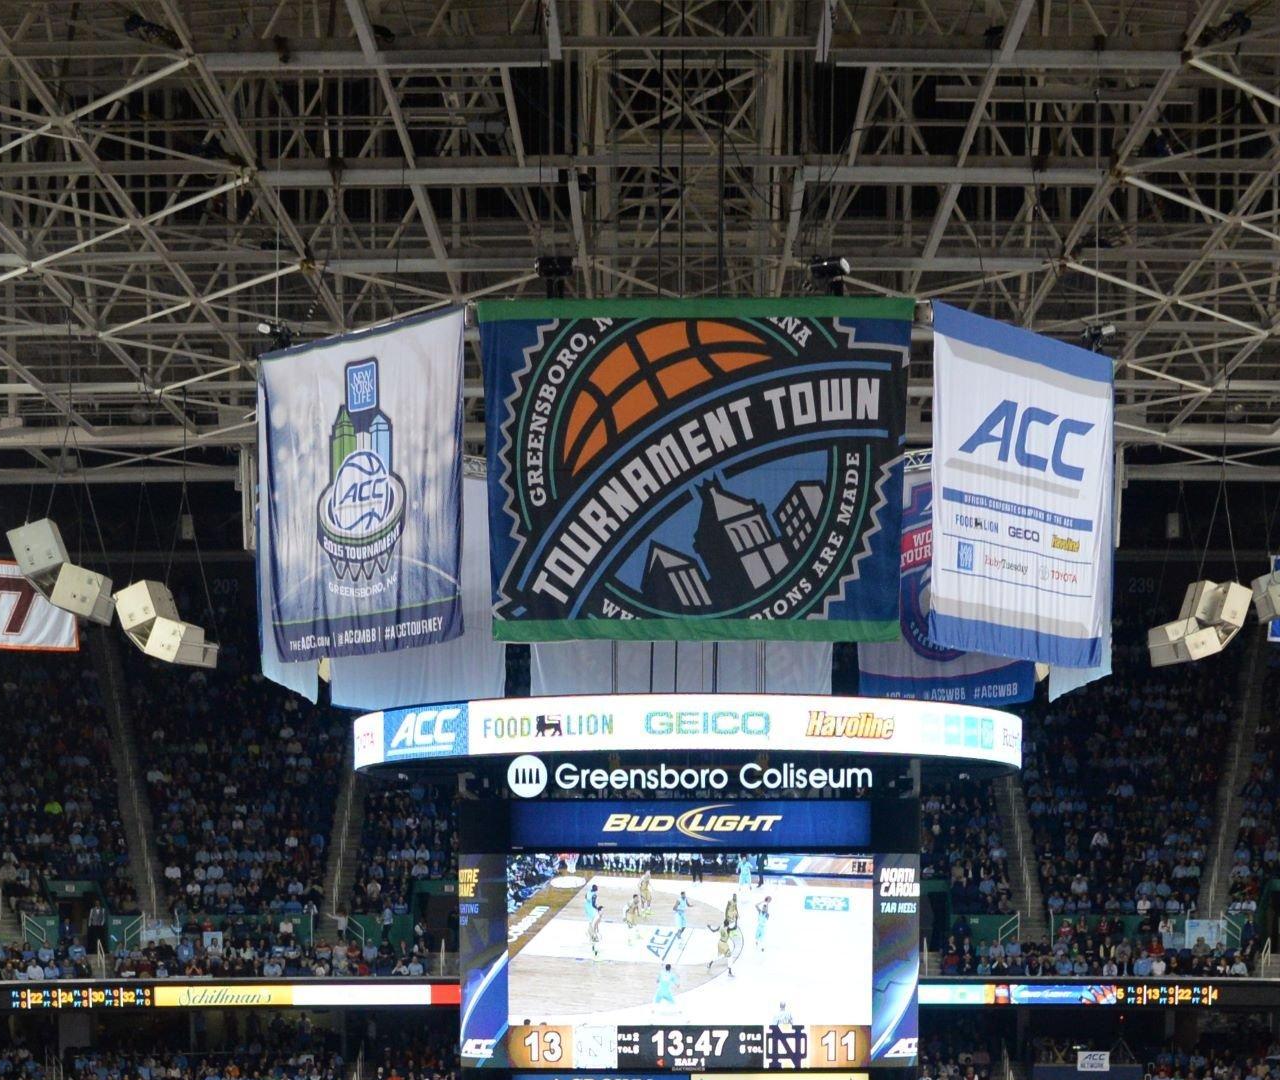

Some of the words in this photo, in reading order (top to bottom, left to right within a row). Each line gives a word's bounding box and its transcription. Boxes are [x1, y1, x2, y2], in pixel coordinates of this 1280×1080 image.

[353, 370, 372, 386] NEW
[353, 391, 372, 405] LIFE
[526, 332, 598, 507] GREENSBORO,
[958, 399, 1096, 482] ACC
[343, 478, 387, 504] ACC
[532, 397, 755, 606] TOURNAMENT
[764, 377, 881, 432] TOWN
[816, 531, 843, 580] ARE
[836, 451, 861, 527] MADE
[983, 519, 999, 534] LION
[324, 536, 344, 556] 2015
[345, 522, 401, 560] TOURNAMENT
[384, 616, 444, 641] #ACCTOURNEY
[973, 682, 1019, 699] #ACCWBB
[390, 708, 462, 747] ACC
[483, 717, 532, 739] FOOD
[566, 714, 615, 736] LION
[805, 710, 896, 740] Havoline
[554, 763, 729, 790] Greensboro
[739, 763, 873, 790] Coliseum
[602, 814, 675, 833] BUD
[687, 814, 784, 833] LIGHT
[879, 867, 916, 883] NORTH
[880, 902, 898, 914] TAR
[898, 902, 917, 914] HEELS
[30, 992, 43, 1004] 22
[61, 991, 74, 1003] 24
[91, 991, 105, 1003] 30
[122, 991, 136, 1003] 32
[1146, 988, 1160, 1000] 13
[1178, 988, 1192, 1000] 22
[523, 1030, 564, 1063] 13
[651, 1029, 729, 1057] 13:47
[820, 1030, 857, 1062] 11
[674, 1058, 699, 1067] HALF
[699, 1058, 706, 1067] 1
[1083, 1053, 1106, 1061] ACC
